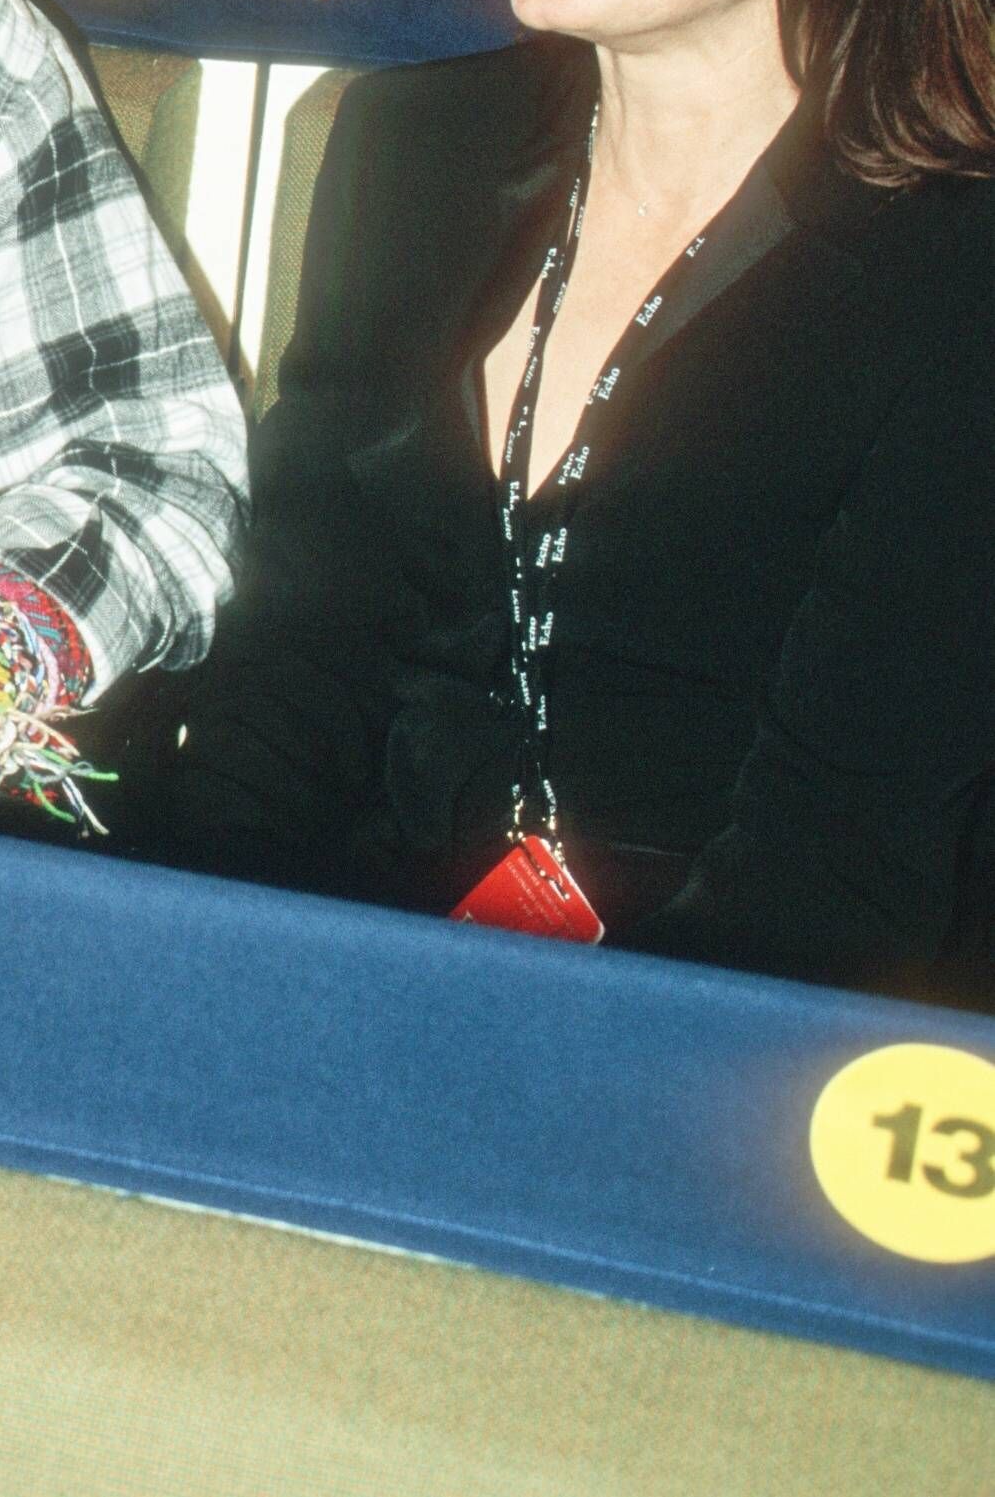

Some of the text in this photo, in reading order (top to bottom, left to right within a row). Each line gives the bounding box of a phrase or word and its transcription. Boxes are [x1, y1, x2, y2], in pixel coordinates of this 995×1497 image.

[635, 295, 662, 327] Echo
[598, 367, 621, 400] Echo
[570, 446, 590, 480] Echo
[535, 533, 552, 568] Echo
[551, 527, 568, 563] Echo
[538, 611, 554, 646] Echo
[872, 1101, 995, 1200] 13
